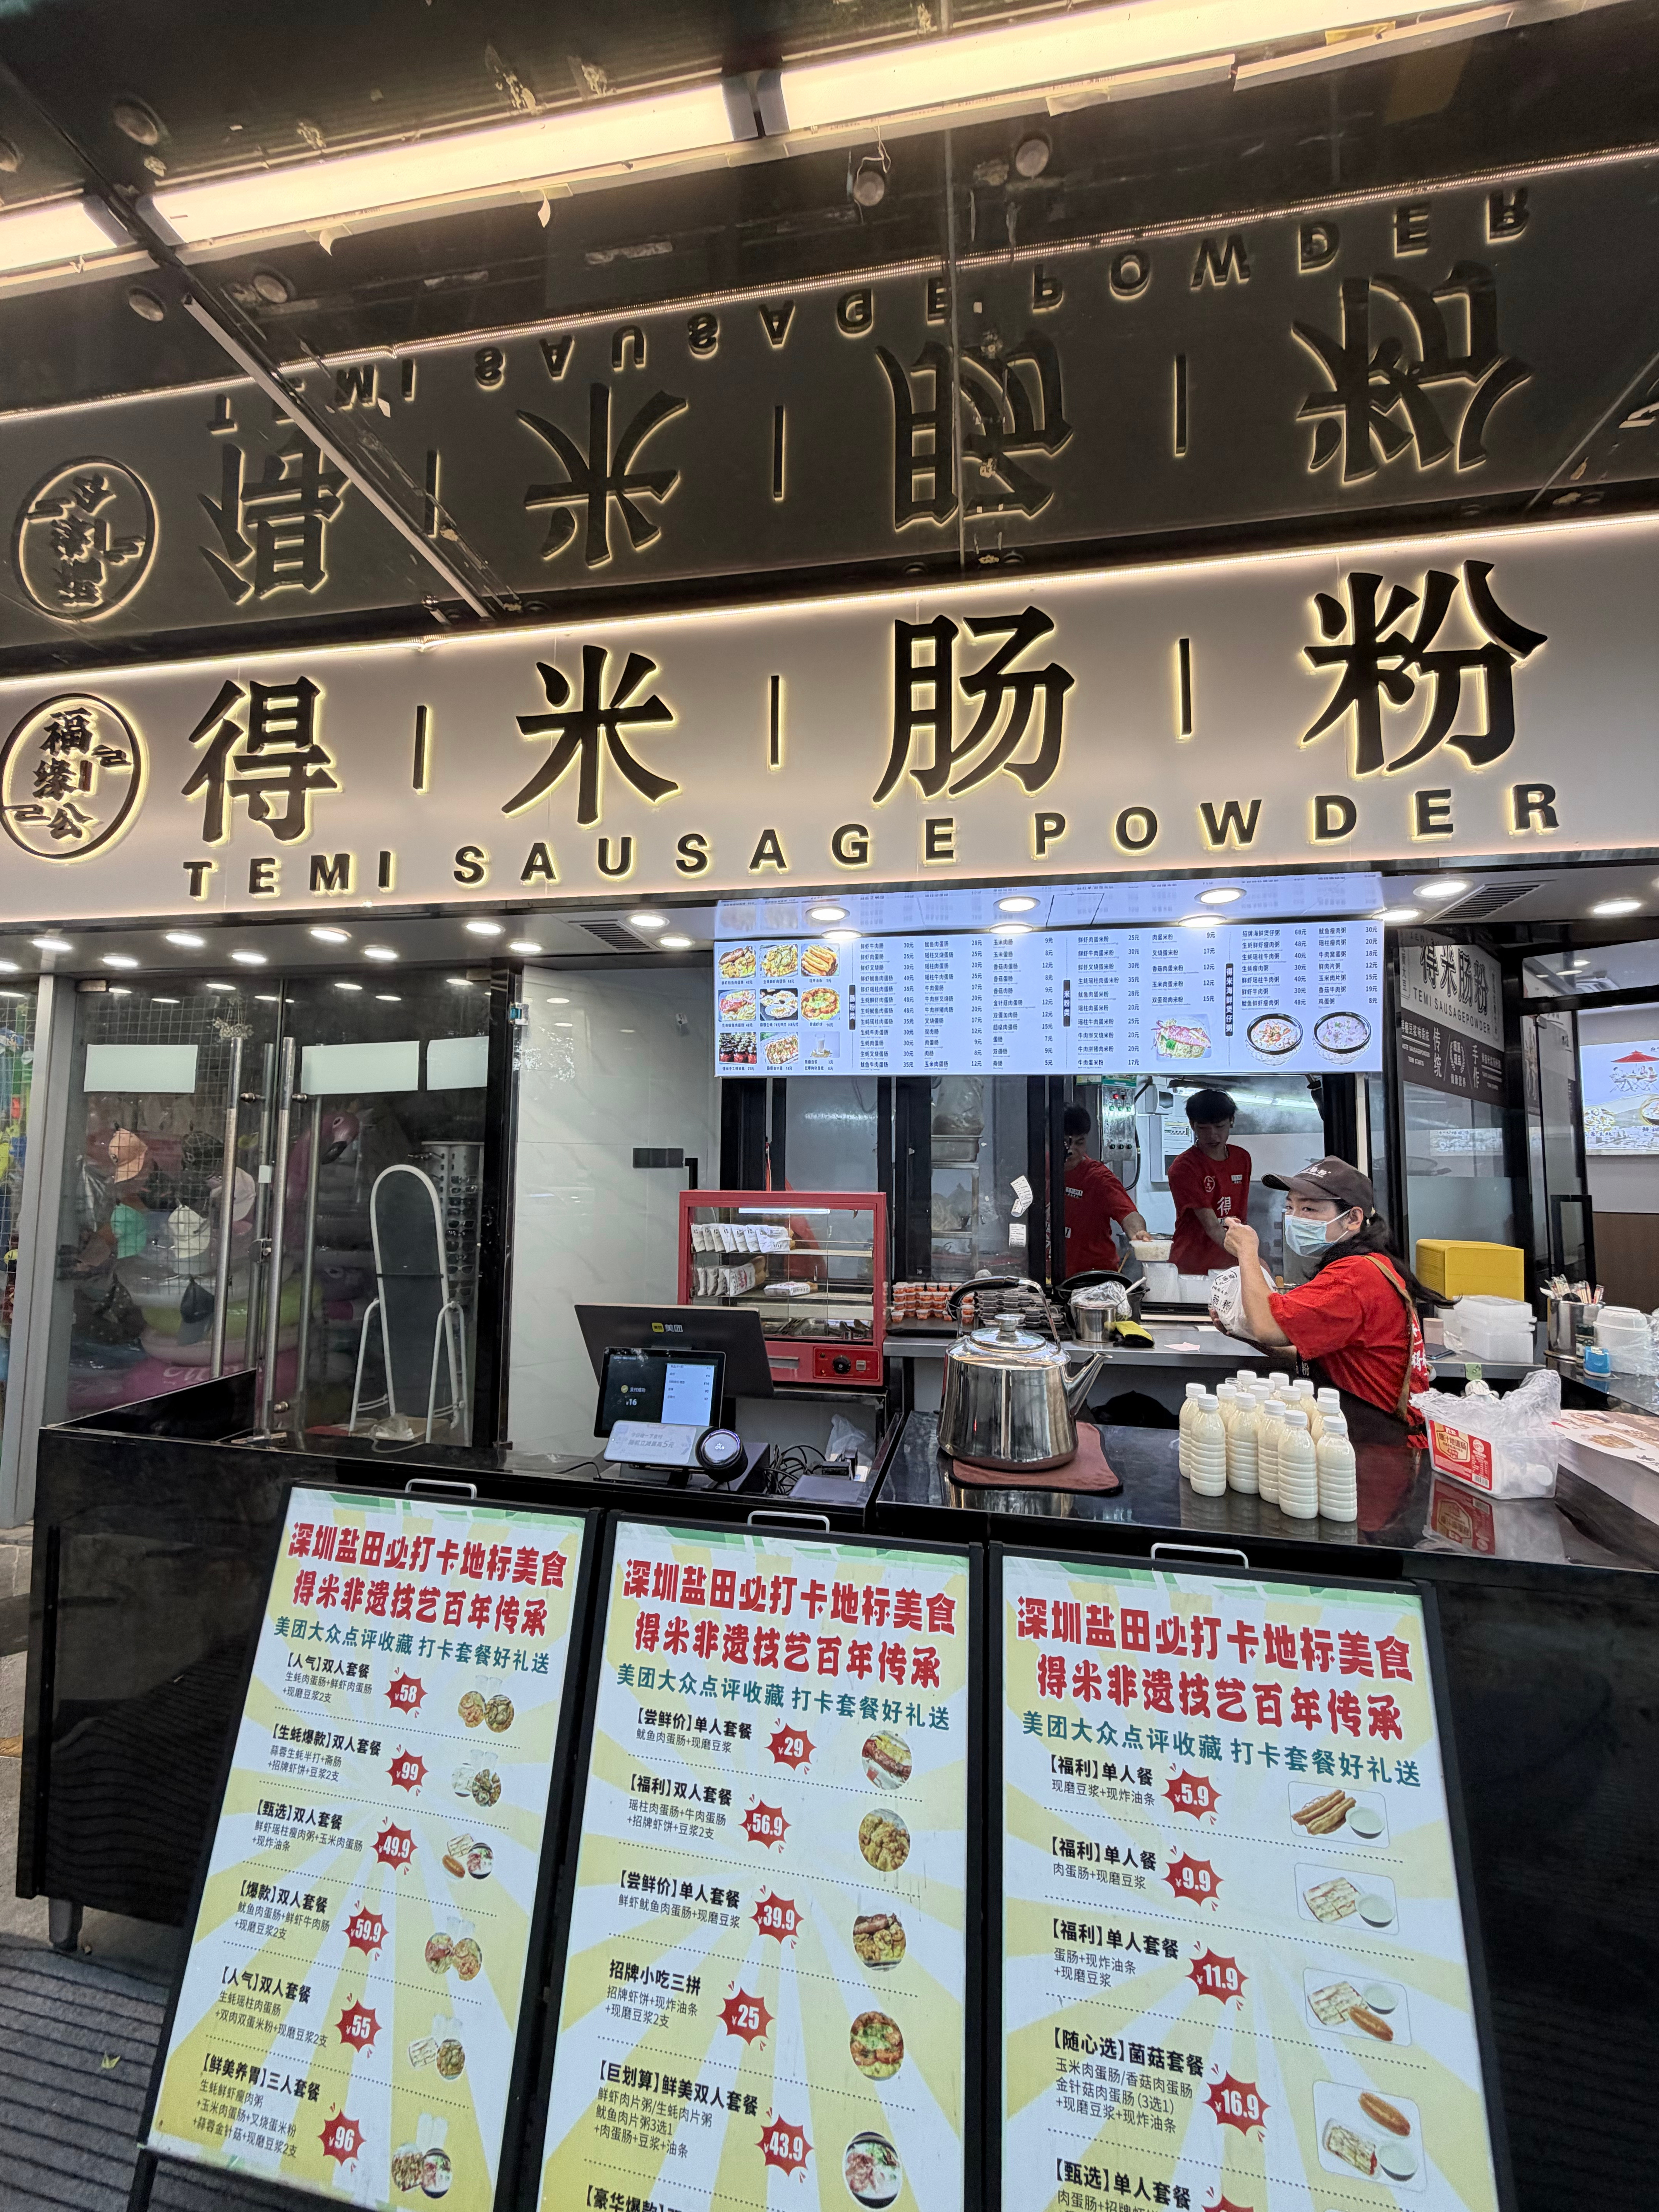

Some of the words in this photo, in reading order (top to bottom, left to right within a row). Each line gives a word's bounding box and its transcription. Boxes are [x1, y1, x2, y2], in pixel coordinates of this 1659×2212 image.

[183, 851, 391, 898] TEMI
[453, 817, 954, 884] SAUSAGE
[1034, 783, 1559, 857] POWDER
[1413, 987, 1432, 1007] TEMI
[1434, 1027, 1442, 1077] 传统
[1472, 1045, 1479, 1089] 手作
[1217, 1196, 1231, 1216] 得
[665, 1324, 684, 1333] 美团
[288, 1522, 567, 1588] 深圳盐田必打卡地标美食
[293, 1570, 547, 1637] 得米非遗技艺百年传承
[622, 1558, 957, 1635] 深圳盐田必打卡地标美食
[274, 1616, 412, 1656] 美团大众点评收藏
[418, 1637, 550, 1674] 打卡套餐好礼送
[634, 1611, 941, 1689] 得米非遗技艺百年传承
[1017, 1596, 1413, 1682] 深圳盐田必打卡地标美食
[288, 1652, 370, 1679] 【人气】双人套餐
[283, 1686, 331, 1703] +现磨豆浆2支
[285, 1671, 373, 1695] 生蚝肉蛋肠+鲜虾肉蛋肠
[616, 1662, 784, 1709] 美团大众点评收藏
[792, 1686, 951, 1731] 打卡套餐好礼送
[1037, 1654, 1402, 1741] 得米非遗技艺百年传承
[272, 1724, 381, 1757] 【生蚝爆款】双人套餐
[636, 1728, 732, 1753] 鱿鱼肉蛋肠+现磨豆浆
[637, 1707, 752, 1741] 【尝鲜价】单人套餐
[270, 1745, 342, 1768] 蒜蓉生蚝半打+斋肠
[1022, 1711, 1223, 1762] 美团大众点评收藏
[1231, 1737, 1421, 1788] 打卡套餐好礼送
[268, 1760, 339, 1782] +招牌虾饼+豆浆2支
[1051, 1755, 1153, 1787] 【福利】单人餐
[630, 1774, 733, 1807] 【福利】双人套餐
[1051, 1779, 1155, 1806] 现磨豆浆+现炸油条
[257, 1799, 343, 1831] 【甄选】双人套餐
[627, 1815, 714, 1839] +招牌虾饼+豆浆2支
[628, 1799, 726, 1826] 瑶柱肉蛋肠+牛肉蛋肠
[252, 1836, 290, 1851] +现炸油条
[254, 1820, 363, 1852] 鲜虾瑶柱瘦肉粥+玉米肉蛋肠
[1052, 1836, 1156, 1871] 【福利】单人餐
[620, 1870, 740, 1909] 【尝鲜价】单人套餐
[1053, 1863, 1146, 1889] 肉蛋肠+现磨豆浆
[240, 1879, 328, 1914] 【爆款】双人套餐
[618, 1894, 740, 1929] 鲜虾鱿鱼肉蛋肠+现磨豆浆
[234, 1919, 287, 1940] +现磨豆浆2支
[237, 1901, 330, 1932] 鱿鱼肉蛋肠+鲜虾牛肉肠
[1053, 1917, 1179, 1960] 【福利】单人套餐
[609, 1959, 701, 1996] 招牌小吃三拼
[1054, 1947, 1136, 1975] 蛋肠+现炸油条
[1054, 1966, 1111, 1988] +现磨豆浆
[221, 1966, 312, 2004] 【人气】双人套餐
[606, 1984, 698, 2017] 招牌虾饼+现炸油条
[218, 1990, 281, 2016] 生蚝瑶柱肉蛋肠
[605, 2004, 670, 2029] +现磨豆浆2支
[215, 2008, 328, 2049] +双肉双蛋米粉+现磨豆浆2支
[1054, 2027, 1204, 2077] 【随心选】菌菇套餐
[199, 2079, 264, 2108] 生蚝鲜虾瘦肉粥
[202, 2053, 321, 2103] 【鲜美养胃】三人套餐
[600, 2060, 759, 2117] 【巨划算】鲜美双人套餐
[1056, 2057, 1193, 2099] 玉米肉蛋肠/香菇肉蛋肠
[596, 2104, 672, 2136] 鱿鱼肉片粥3选1
[598, 2087, 712, 2128] 鲜虾肉片粥/生蚝肉片粥
[1056, 2099, 1176, 2133] +现磨豆浆+现炸油条
[194, 2116, 297, 2158] +蒜蓉金针菇+现磨豆浆2支
[594, 2125, 689, 2159] +肉蛋肠+豆浆+油条
[1056, 2157, 1191, 2210] 【甄选】单人套餐
